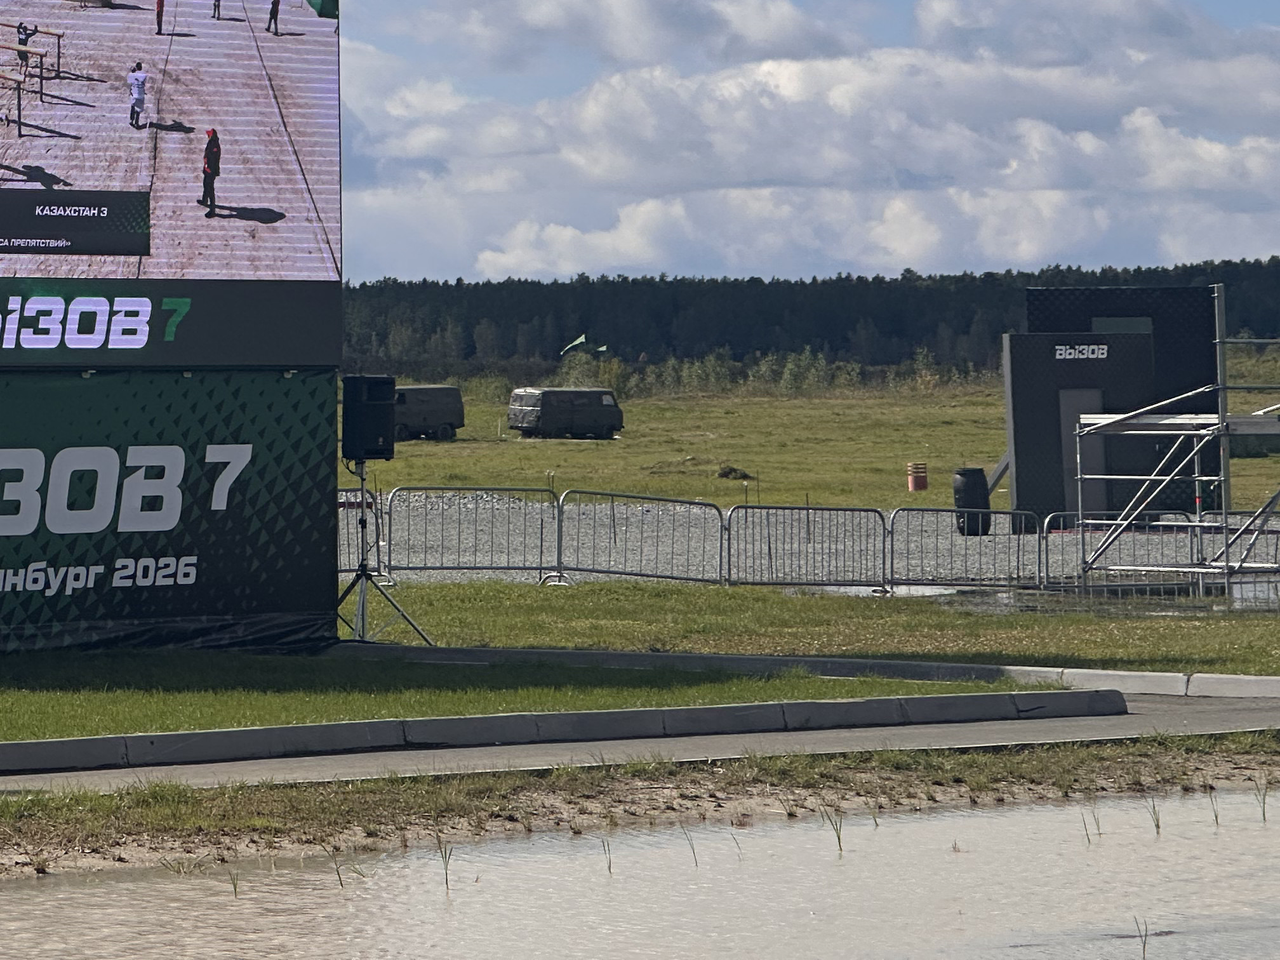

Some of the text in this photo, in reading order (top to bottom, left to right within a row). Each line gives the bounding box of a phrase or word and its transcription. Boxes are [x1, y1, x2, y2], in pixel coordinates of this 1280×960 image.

[35, 205, 108, 217] КАЗАХСТАН 3
[10, 238, 72, 248] ПРЕПЯТСТВИЙ»
[161, 297, 192, 342] 7
[1054, 344, 1108, 360] ВЫЗОВ
[204, 443, 254, 511] 7
[111, 555, 198, 588] 2026
